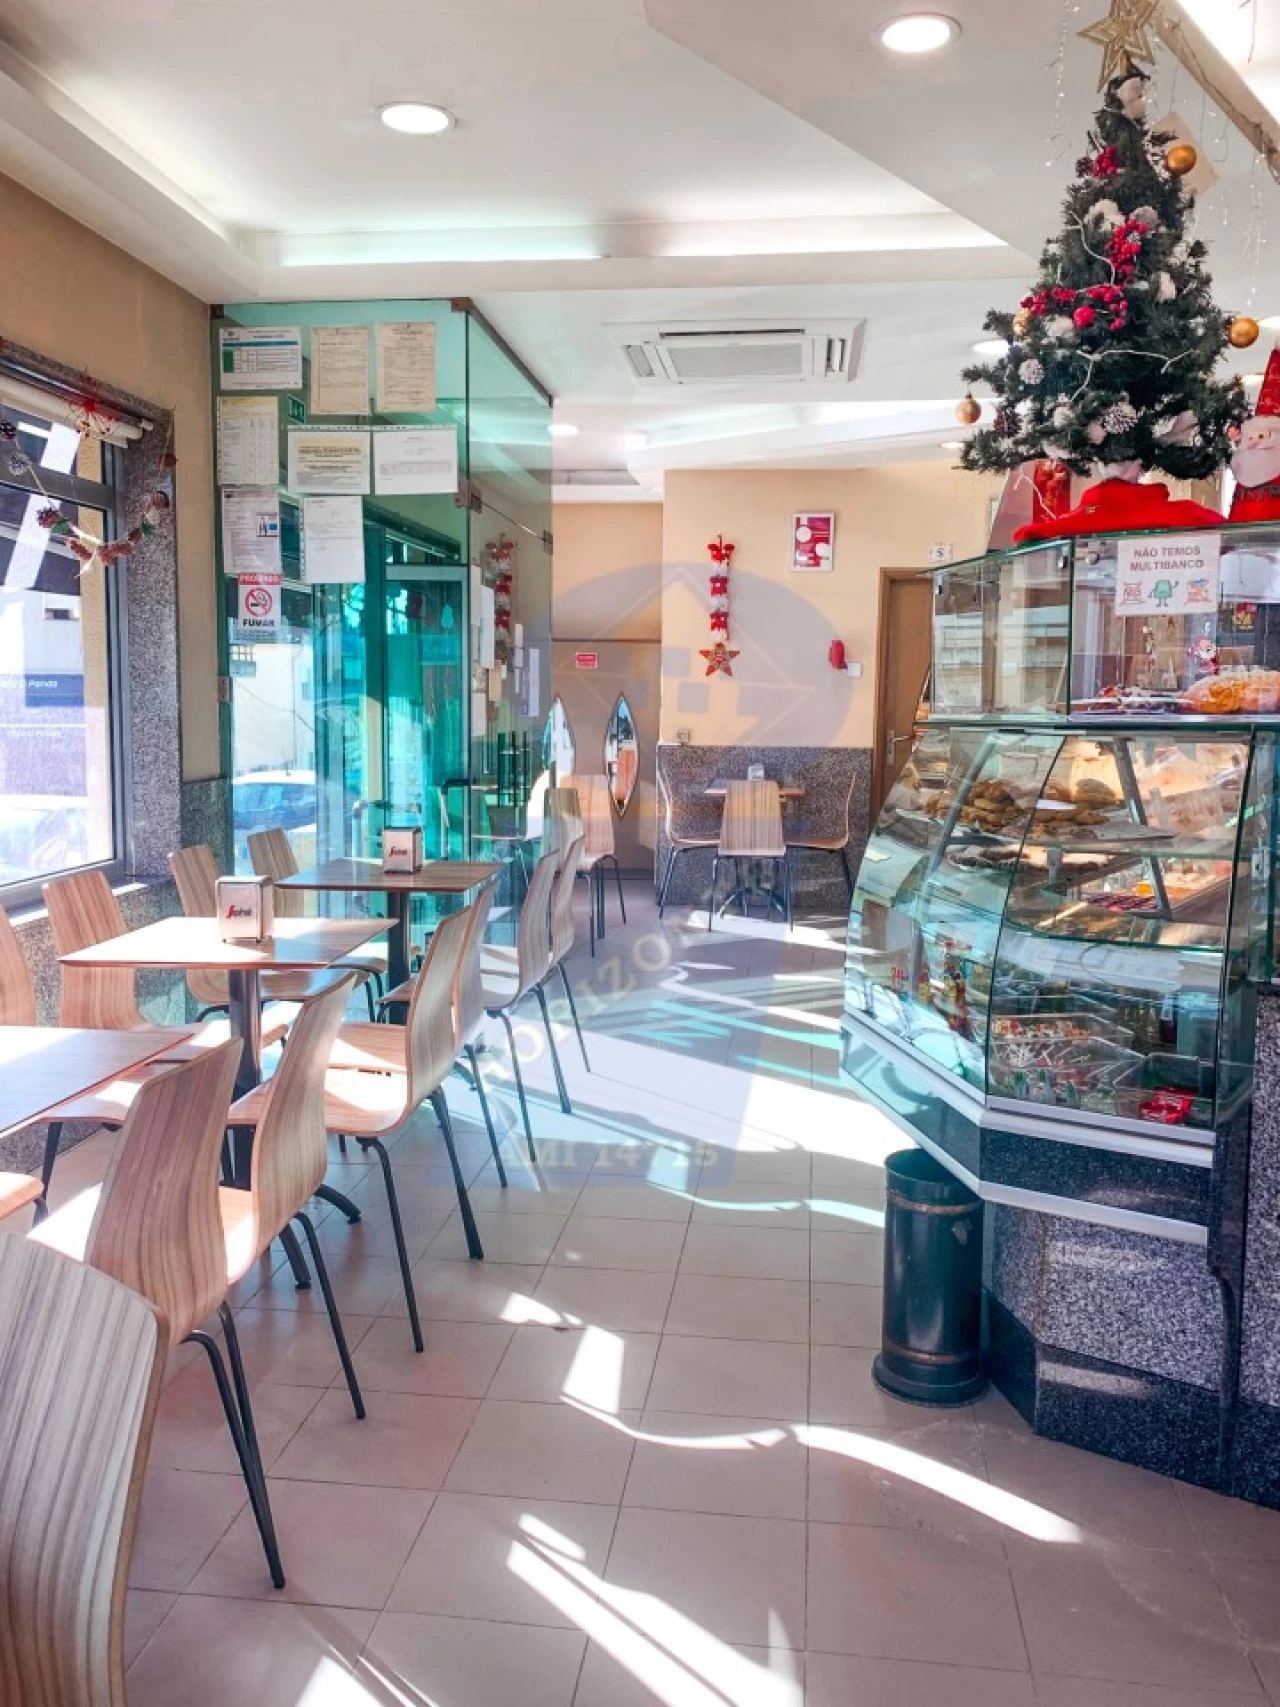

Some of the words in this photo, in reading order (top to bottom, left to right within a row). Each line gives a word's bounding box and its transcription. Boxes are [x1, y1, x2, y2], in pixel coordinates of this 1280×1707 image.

[1134, 548, 1158, 558] NÃO
[1162, 545, 1201, 556] TEMOS
[1130, 560, 1204, 571] MULTIBANCO
[243, 618, 275, 627] FUMAR
